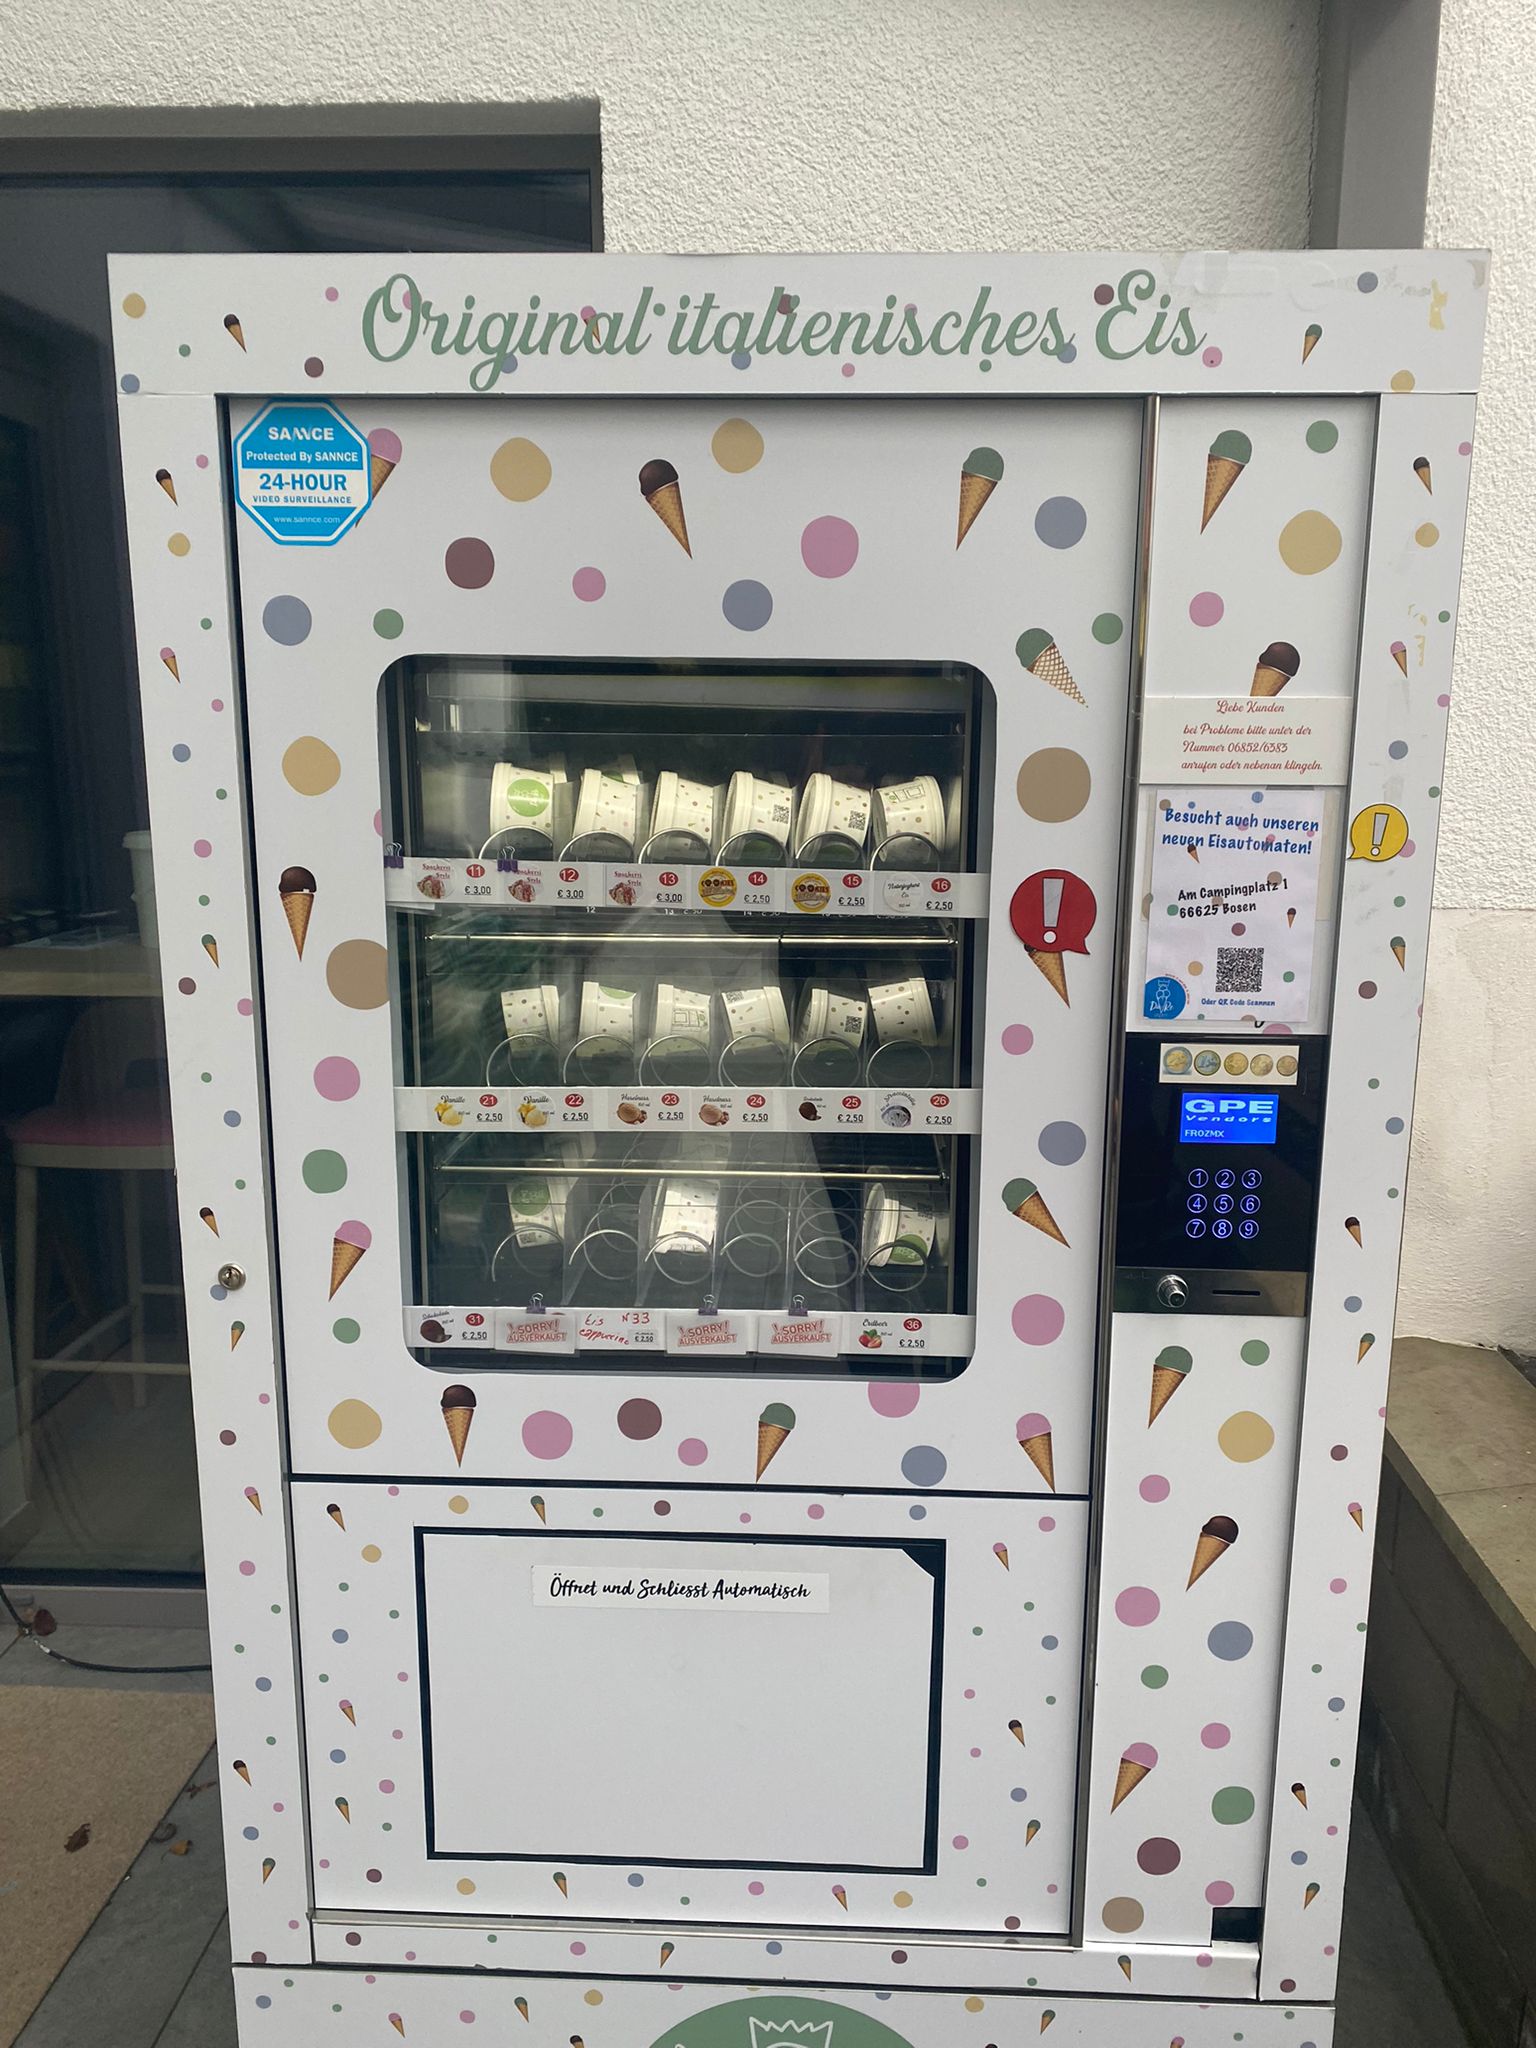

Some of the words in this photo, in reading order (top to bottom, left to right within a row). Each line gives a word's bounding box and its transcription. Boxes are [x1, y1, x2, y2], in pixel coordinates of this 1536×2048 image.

[362, 273, 653, 392] Original
[667, 286, 1076, 357] italienisches
[1095, 269, 1208, 361] Eis
[246, 451, 297, 461] Protected
[299, 451, 312, 463] By
[314, 452, 358, 462] SANNCE
[259, 473, 347, 491] 24-HOUR
[252, 495, 280, 503] VIDEO
[283, 495, 352, 504] SURVEILLANCE
[273, 516, 340, 524] www.sannce.com
[1216, 700, 1244, 714] Liebe
[1246, 700, 1285, 713] Kunden
[1183, 724, 1198, 735] bei
[1199, 722, 1244, 735] Probleme
[1246, 724, 1266, 735] bitte
[1268, 725, 1293, 735] unter
[1295, 725, 1312, 735] der
[1182, 740, 1226, 752] Nummer
[1181, 760, 1217, 773] anrufen
[1219, 760, 1241, 770] oder
[1243, 760, 1282, 770] nebenan
[1164, 808, 1222, 826] Besucht
[1225, 813, 1258, 828] auch
[1262, 819, 1319, 832] unseren
[1162, 834, 1204, 846] neuen
[1208, 834, 1312, 855] Eisautomaten!
[470, 865, 483, 877] 11
[561, 870, 576, 881] 12
[661, 873, 676, 885] 13
[751, 873, 765, 884] 14
[847, 875, 859, 886] 15
[935, 880, 947, 890] 16
[1177, 889, 1197, 901] Am
[1199, 880, 1279, 899] Campingplatz
[1282, 878, 1289, 890] 1
[464, 886, 471, 895] €
[557, 889, 564, 898] €
[656, 893, 663, 902] €
[744, 894, 750, 903] €
[838, 897, 845, 906] €
[926, 901, 932, 910] €
[1179, 904, 1219, 918] 66625
[1222, 902, 1257, 914] Bosen
[1201, 998, 1217, 1006] Oder
[1229, 998, 1245, 1007] Code
[1246, 999, 1276, 1007] Scannen
[440, 1095, 465, 1104] Vanille
[482, 1096, 495, 1105] 21
[523, 1095, 550, 1105] Vanille
[568, 1095, 582, 1105] 22
[664, 1095, 677, 1105] 23
[749, 1096, 763, 1106] 24
[845, 1098, 858, 1108] 25
[934, 1096, 947, 1106] 26
[1185, 1099, 1274, 1114] GPE
[477, 1113, 483, 1121] €
[563, 1113, 569, 1121] €
[658, 1112, 664, 1120] €
[742, 1114, 748, 1122] €
[838, 1115, 843, 1123] €
[926, 1116, 931, 1124] €
[1186, 1115, 1272, 1123] Vendors
[1184, 1129, 1225, 1138] FROZMX
[1195, 1172, 1202, 1185] 1
[1220, 1172, 1230, 1186] 2
[1247, 1172, 1256, 1186] 3
[1192, 1197, 1202, 1210] 4
[1219, 1197, 1228, 1211] 5
[1245, 1197, 1255, 1211] 6
[1192, 1222, 1201, 1235] 7
[1217, 1222, 1227, 1236] 8
[1244, 1223, 1254, 1236] 9
[469, 1315, 482, 1325] 31
[632, 1312, 650, 1324] 33
[863, 1318, 888, 1327] Erdbeer
[906, 1320, 919, 1330] 36
[462, 1332, 468, 1340] €
[507, 1331, 567, 1344] AUSVERKAUFT
[678, 1333, 737, 1347] AUSVERKAUFT
[771, 1333, 832, 1344] AUSVERKAUFT
[900, 1339, 905, 1348] €
[550, 1573, 597, 1597] Öffnet
[602, 1579, 635, 1597] und
[637, 1579, 709, 1599] Schliesst
[712, 1579, 811, 1600] Automatisch
